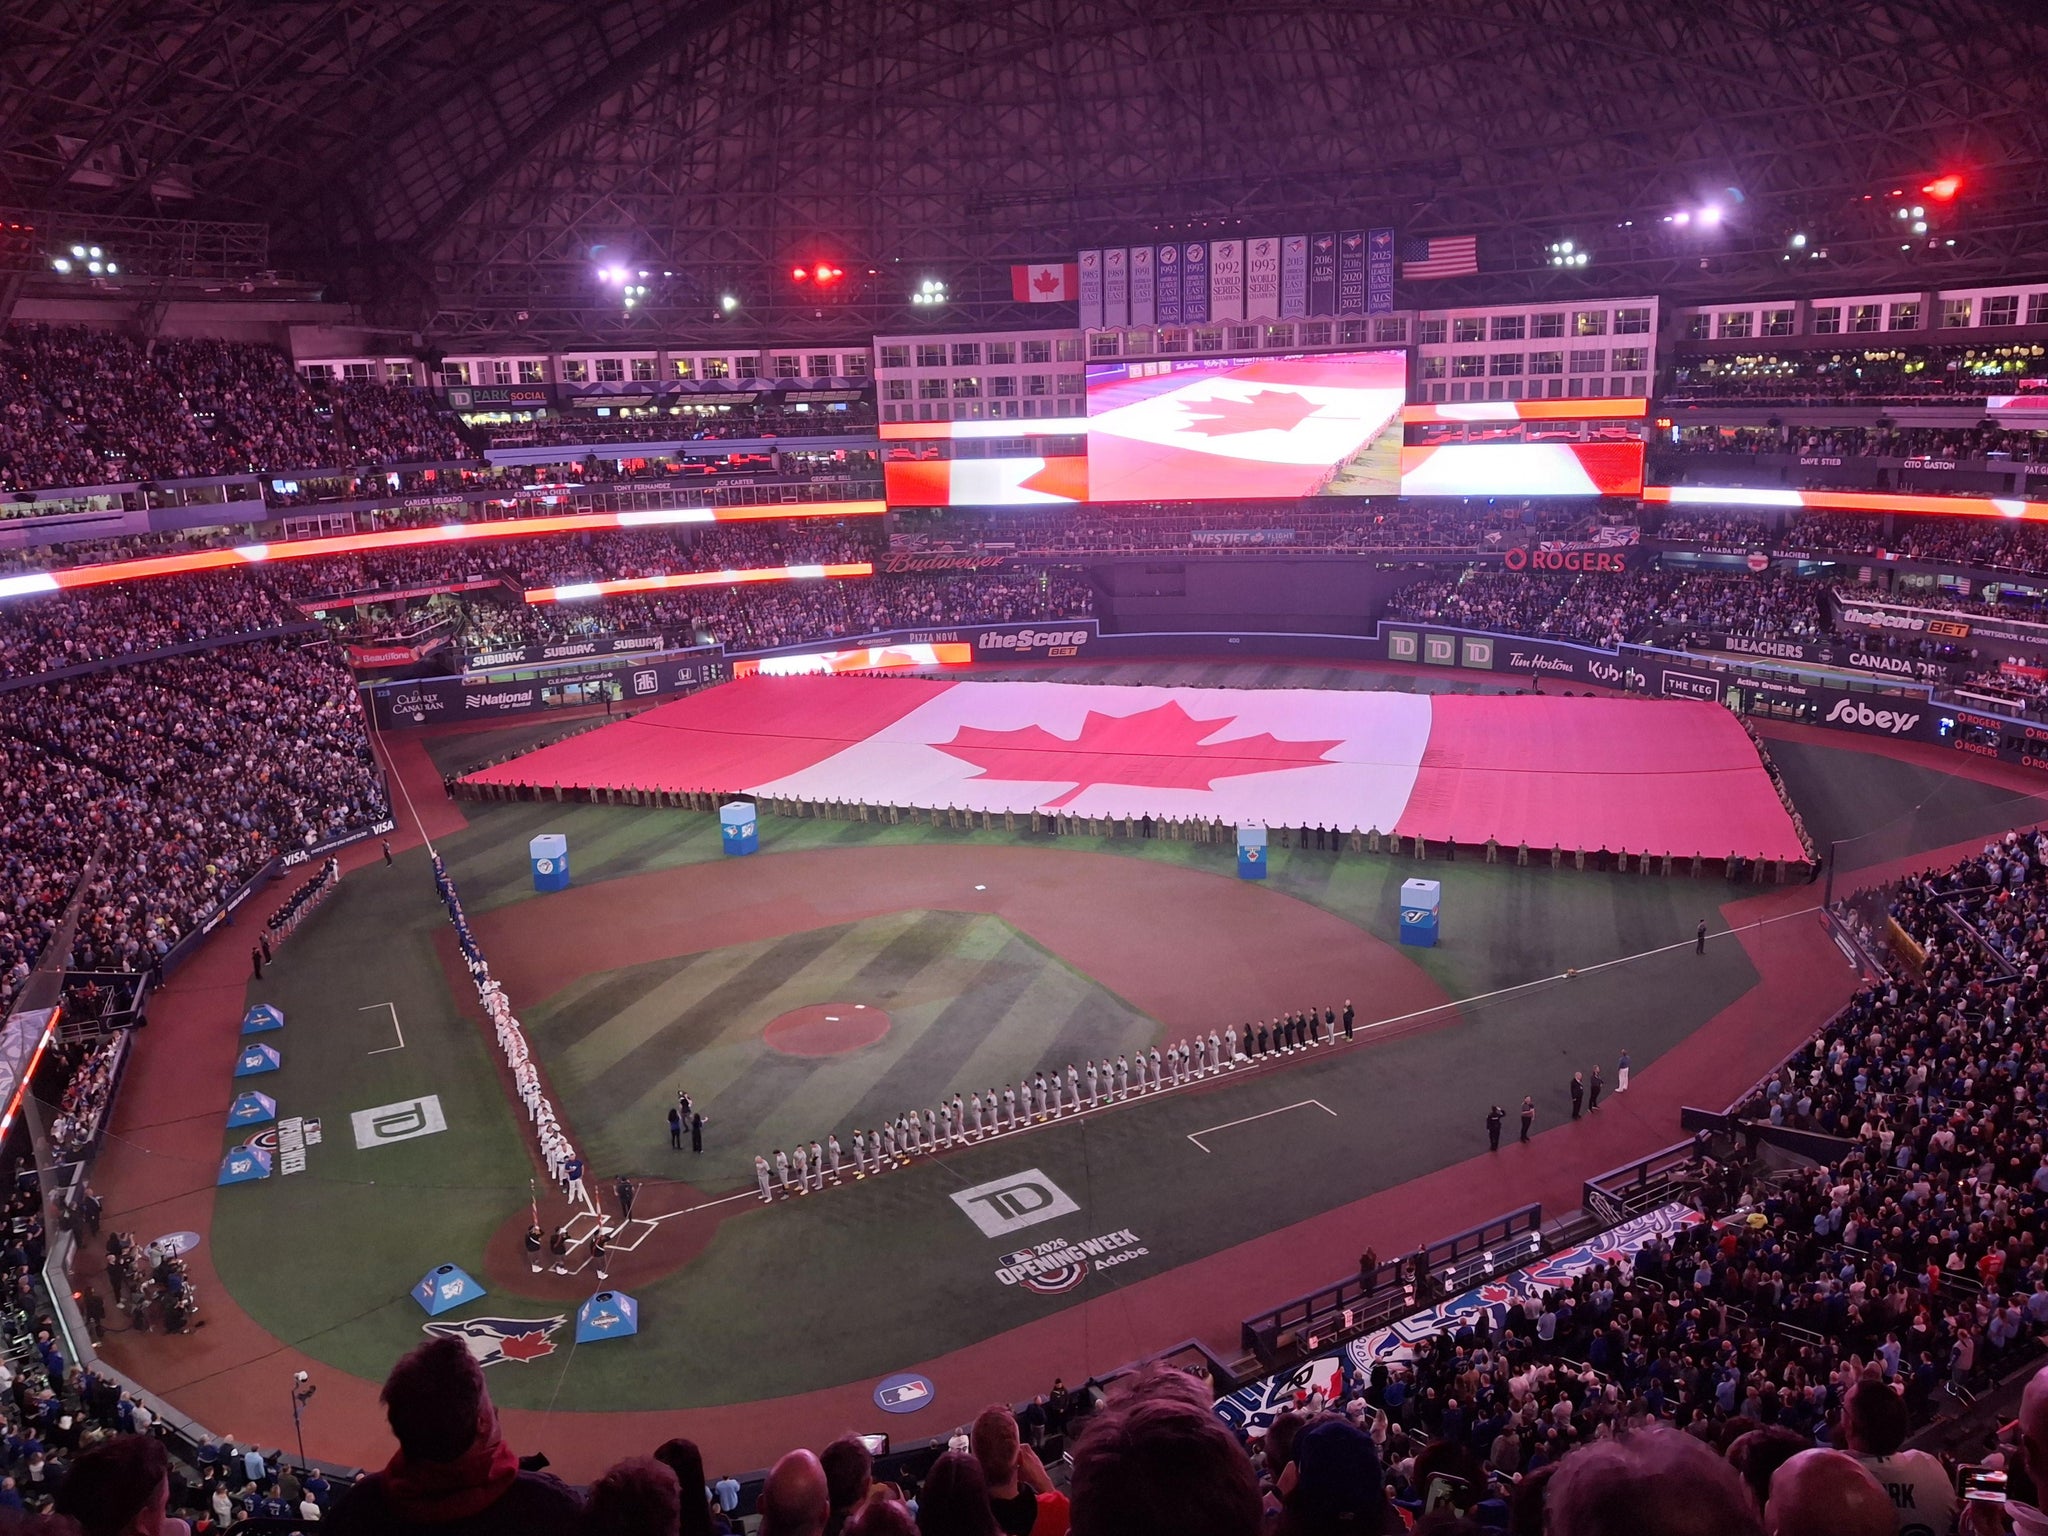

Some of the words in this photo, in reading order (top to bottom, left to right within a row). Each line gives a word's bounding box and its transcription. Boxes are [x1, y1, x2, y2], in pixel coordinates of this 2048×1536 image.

[1314, 256, 1332, 264] 2016
[1372, 251, 1391, 260] 2025
[1160, 266, 1177, 274] 1992
[1215, 262, 1239, 274] 1992
[1252, 259, 1276, 272] 1993
[1314, 267, 1333, 276] ALDS
[1342, 272, 1362, 282] 2020
[1214, 276, 1240, 286] WORLD
[1250, 274, 1276, 283] WORLD
[1371, 275, 1390, 283] EAST
[1213, 286, 1240, 295] SERIES
[1250, 284, 1276, 292] SERIES
[1342, 286, 1362, 294] 2022
[1372, 294, 1391, 302] ALCS
[1161, 306, 1178, 314] ALCS
[1188, 304, 1204, 313] ALCS
[451, 392, 470, 406] TD
[474, 390, 509, 400] PARK
[510, 392, 546, 400] SOCIAL
[1801, 458, 1818, 466] DAVE
[1821, 458, 1841, 466] STIEB
[1904, 460, 1922, 470] CITO
[1924, 462, 1955, 470] GASTON
[2025, 466, 2038, 474] PAT
[404, 498, 430, 507] CARLOS
[432, 496, 464, 504] DELGADO
[1192, 533, 1250, 543] WESTJET
[1702, 546, 1732, 554] CANADA
[1773, 550, 1810, 560] BLEACHERS
[880, 553, 1004, 572] Budweiser
[1532, 552, 1626, 573] ROGERS
[1844, 609, 1924, 630] theScore
[1930, 622, 1966, 636] BET
[910, 633, 934, 643] PIZZA
[936, 632, 958, 642] NOVA
[979, 630, 1088, 648] theScore
[543, 643, 595, 658] SUBWAY
[1392, 637, 1414, 654] TD
[1428, 640, 1452, 658] TD
[1726, 638, 1803, 658] BLEACHERS
[1466, 643, 1490, 662] TD
[472, 651, 526, 667] SUBWAY
[1510, 652, 1530, 668] Tim
[1531, 654, 1573, 672] Hortons
[1850, 653, 1912, 674] CANADA
[1669, 679, 1688, 691] THE
[1692, 682, 1712, 694] KEG
[1737, 678, 1760, 687] Active
[397, 694, 438, 704] CLEARLY
[482, 690, 532, 706] National
[1826, 698, 1920, 733] Sobeys
[1967, 716, 2000, 729] ROGERS
[1964, 743, 1998, 758] ROGERS
[372, 820, 394, 836] VISA
[283, 851, 306, 866] VISA
[967, 1182, 1054, 1220] TD
[1034, 1238, 1068, 1256] 2026
[994, 1245, 1086, 1285] OPENING
[1079, 1228, 1140, 1256] WEEK
[1094, 1246, 1149, 1271] Adobe
